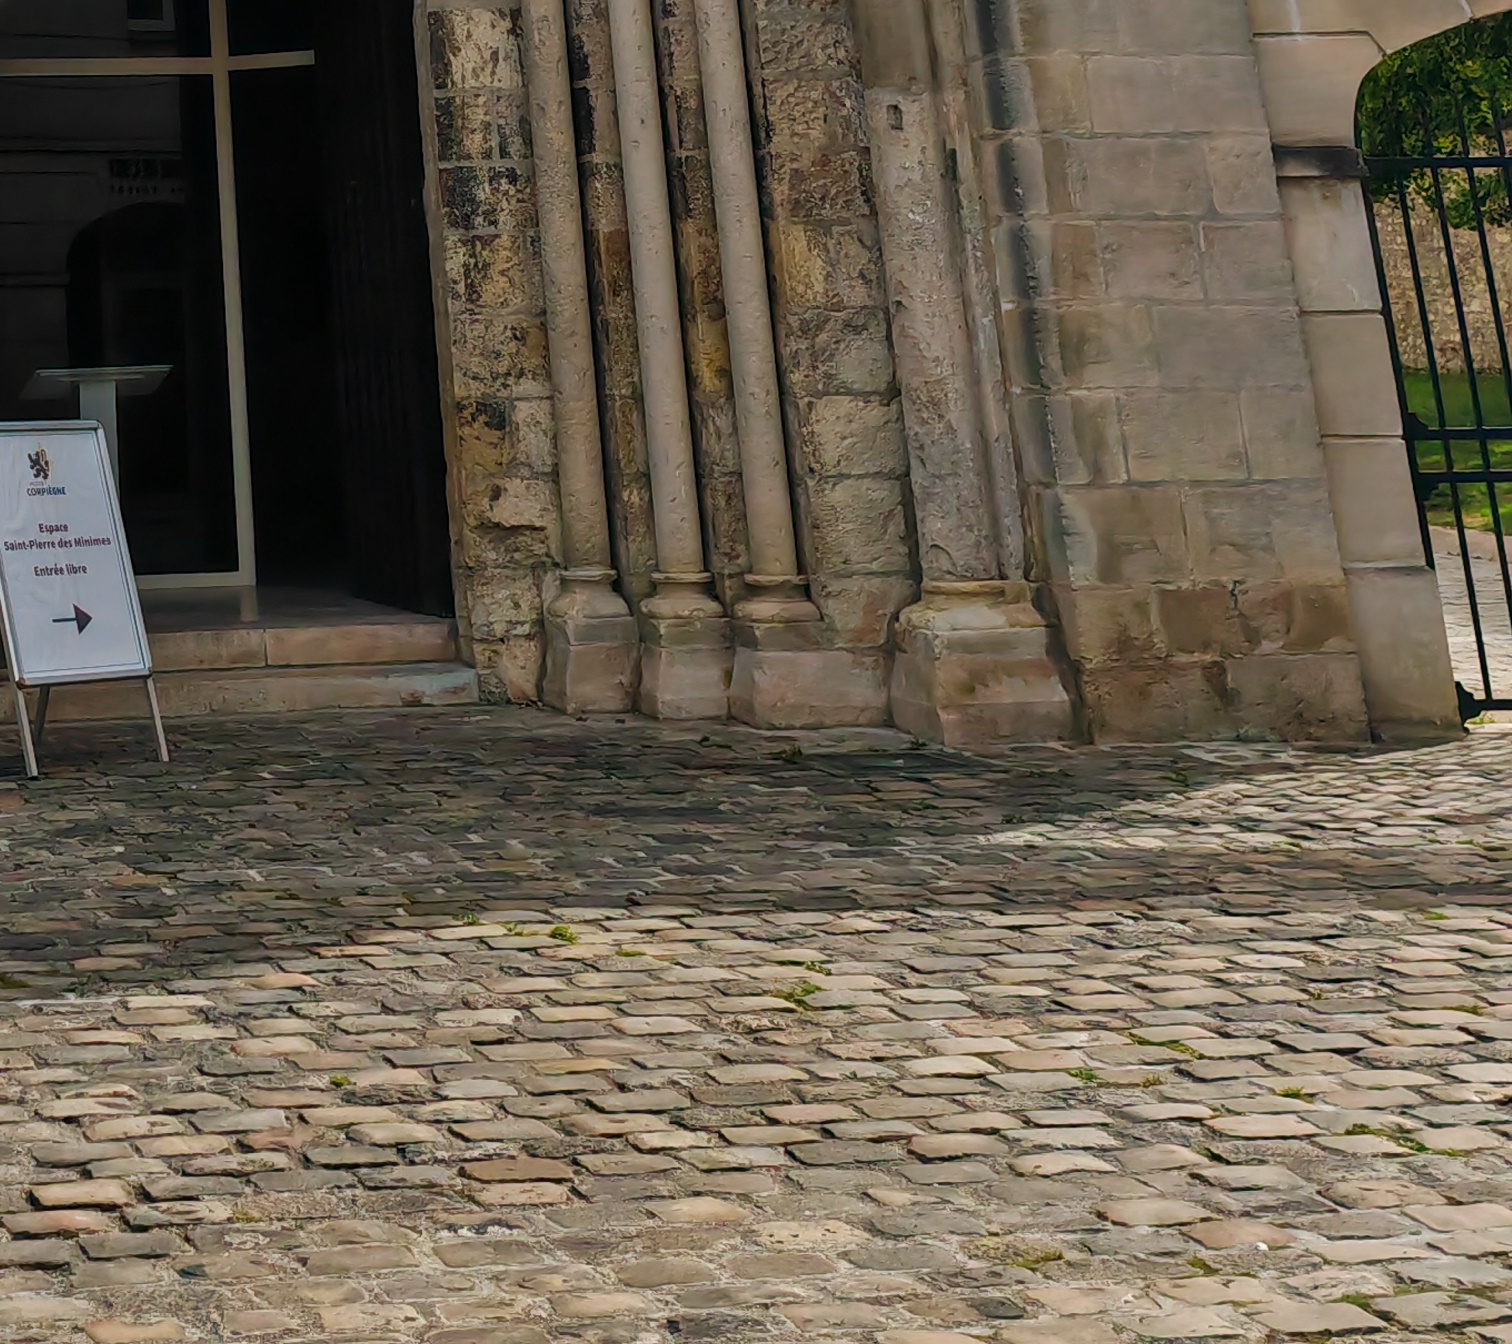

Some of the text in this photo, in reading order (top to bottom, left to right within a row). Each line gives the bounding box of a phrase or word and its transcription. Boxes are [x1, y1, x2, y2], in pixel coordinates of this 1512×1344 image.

[38, 523, 69, 535] Espace
[3, 535, 112, 551] Saint-Pierre des Minimes
[33, 563, 88, 577] Entrée libre
